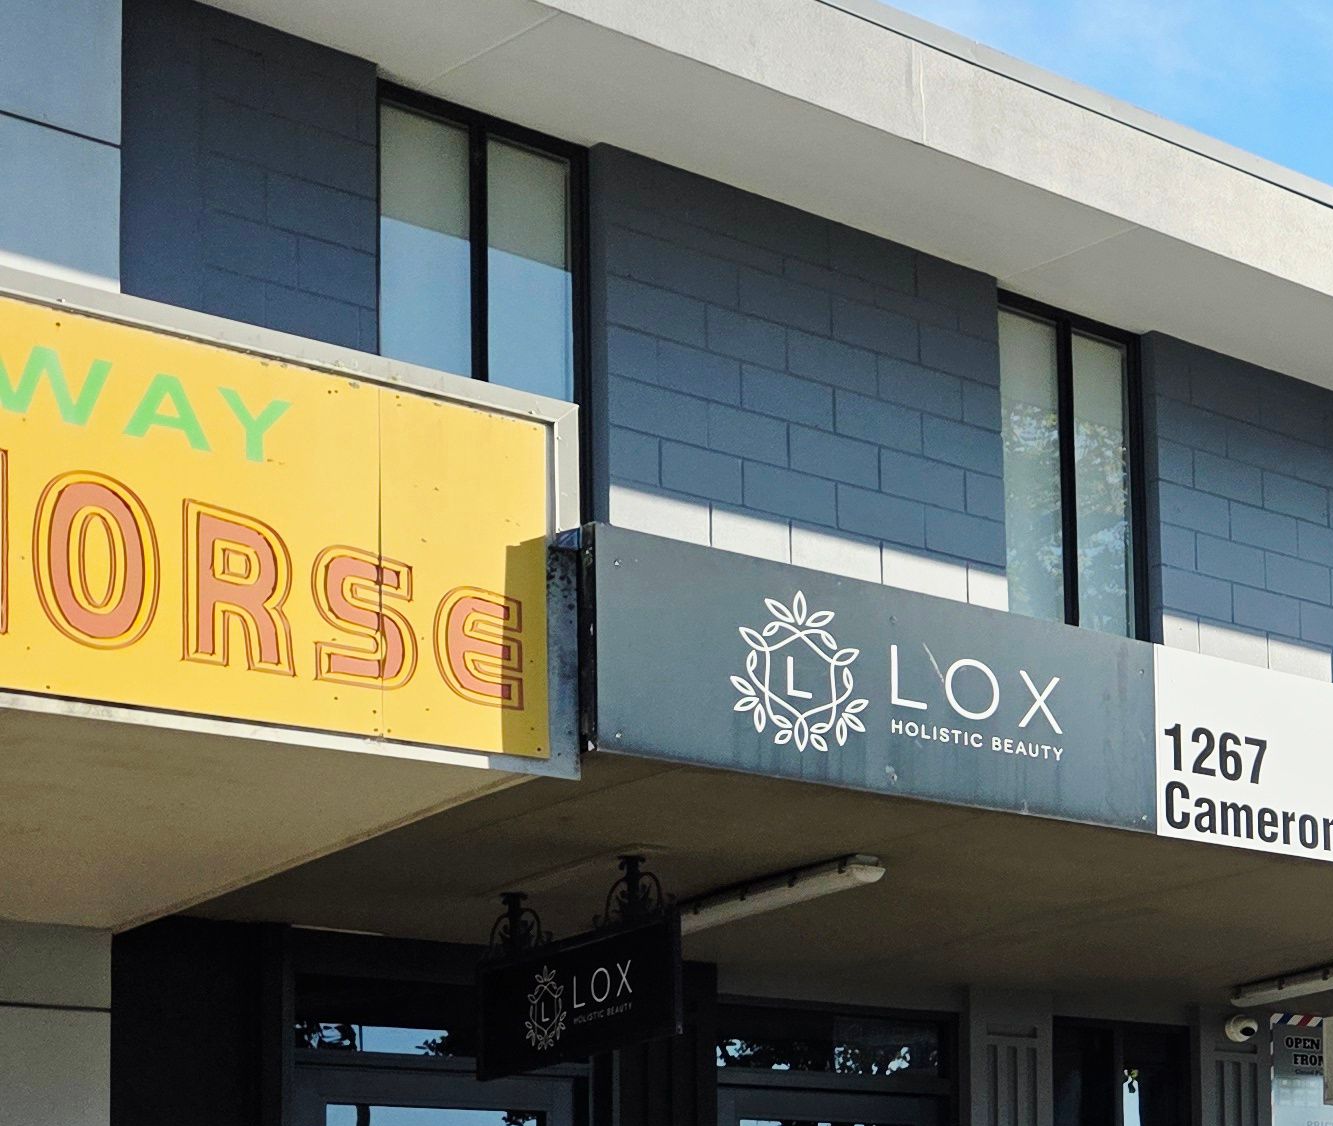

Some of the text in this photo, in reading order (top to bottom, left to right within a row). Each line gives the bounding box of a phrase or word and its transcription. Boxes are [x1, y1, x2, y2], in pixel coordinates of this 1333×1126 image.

[0, 450, 524, 710] ORSE
[891, 644, 1062, 734] LOX
[891, 719, 1064, 761] HOLISTIC BEAUTY
[1164, 723, 1268, 785] 1267
[573, 960, 633, 1009] LOX
[1285, 1037, 1320, 1050] OPEN
